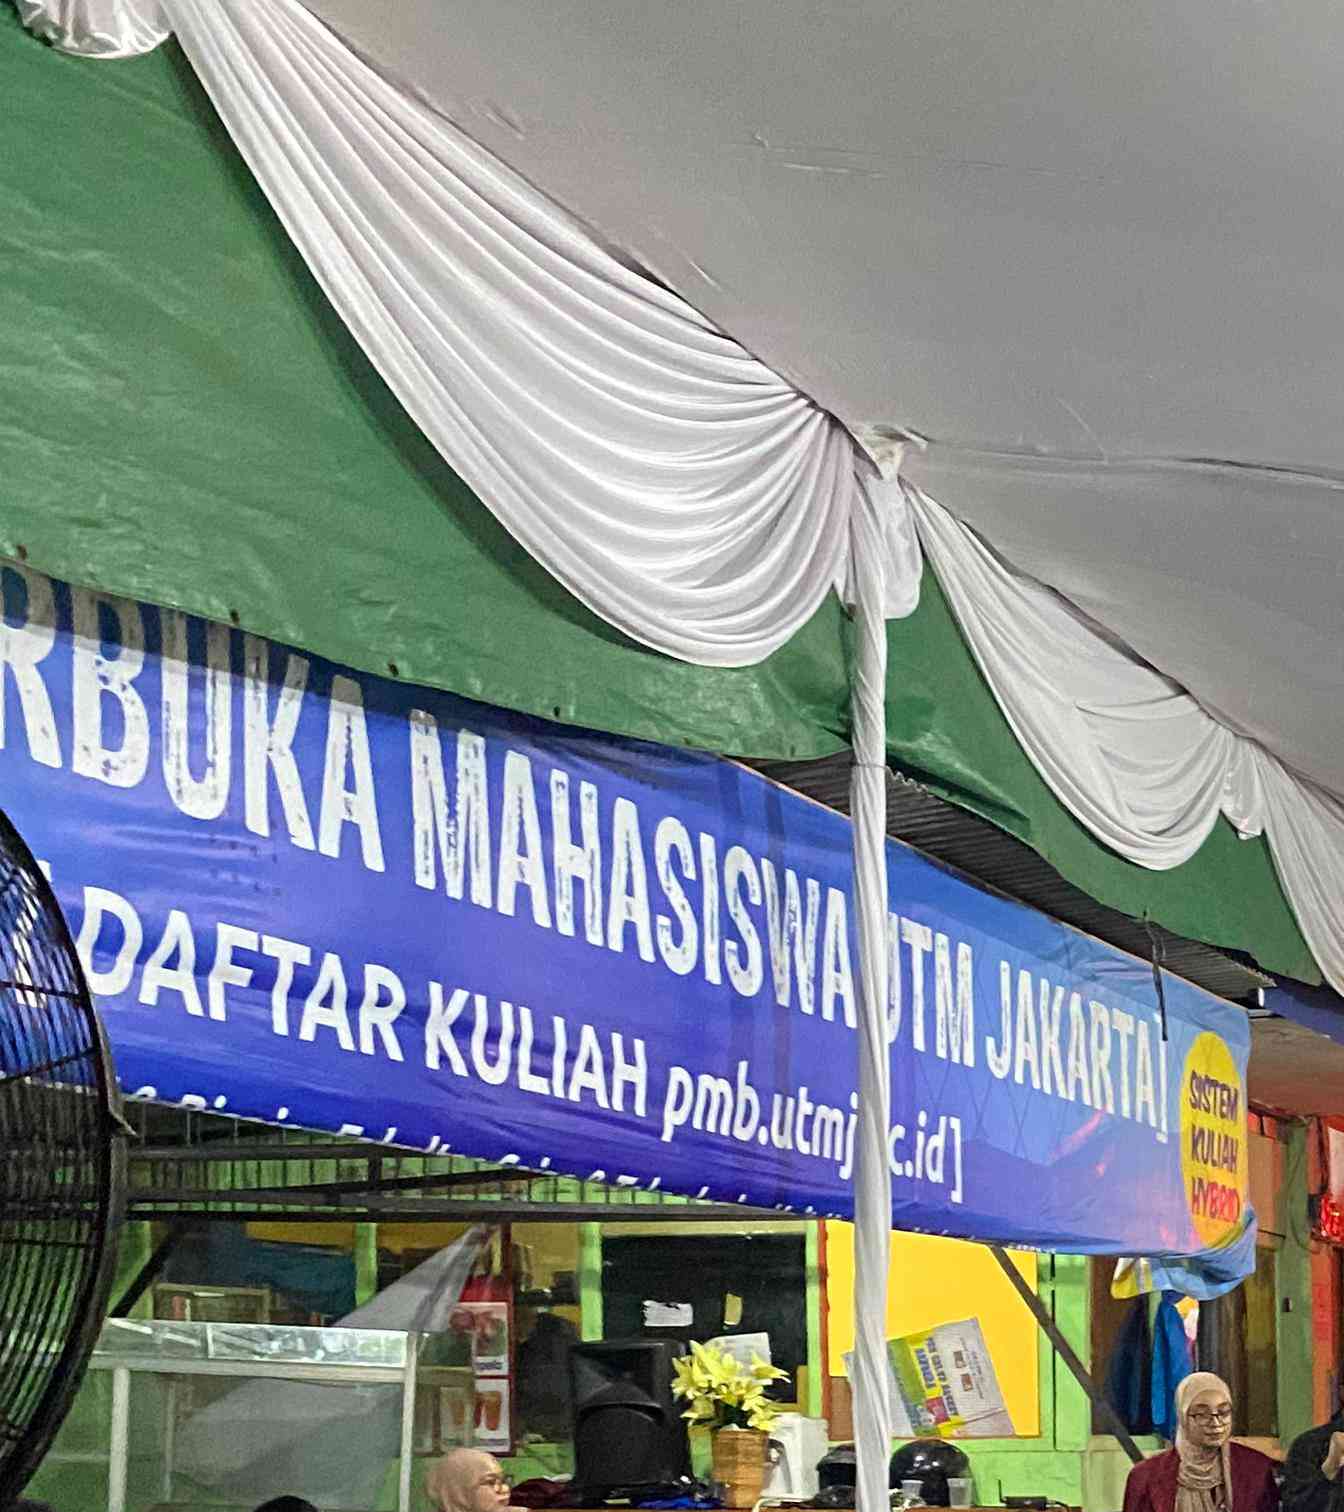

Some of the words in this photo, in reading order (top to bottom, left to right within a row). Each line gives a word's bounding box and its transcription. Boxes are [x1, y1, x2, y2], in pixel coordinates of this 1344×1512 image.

[409, 708, 858, 1029] MAHASISWA
[75, 886, 404, 1062] DAFTAR
[425, 981, 646, 1117] KULIAH
[1189, 1069, 1239, 1122] SISTEM
[1191, 1123, 1239, 1174] KULIAH
[1191, 1177, 1241, 1223] HYBRID
